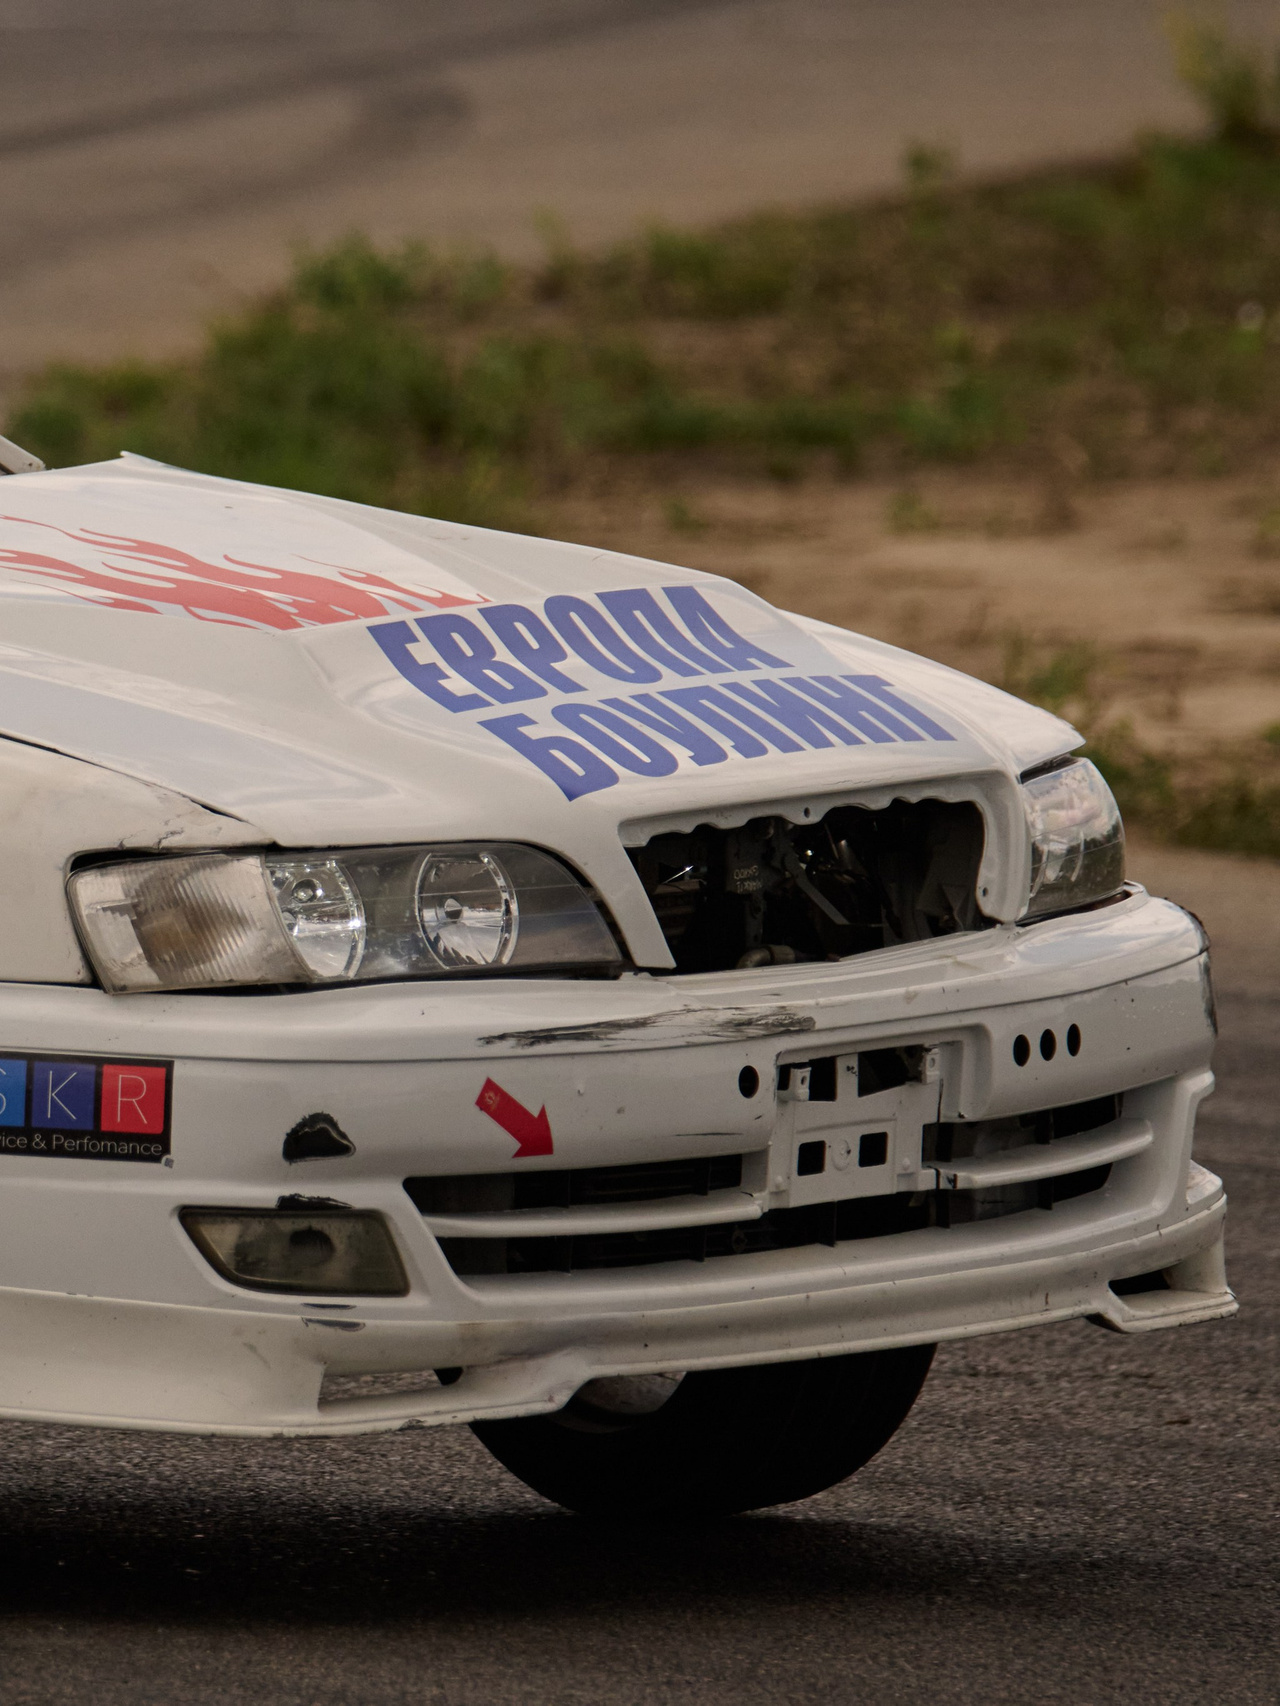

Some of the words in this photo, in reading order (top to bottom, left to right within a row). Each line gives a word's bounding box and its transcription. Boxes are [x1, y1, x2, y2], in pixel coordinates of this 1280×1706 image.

[366, 586, 795, 713] ЕВРОПА
[477, 674, 958, 802] БОУЛИНГ
[32, 1133, 47, 1149] &
[53, 1134, 162, 1156] Perfomance
